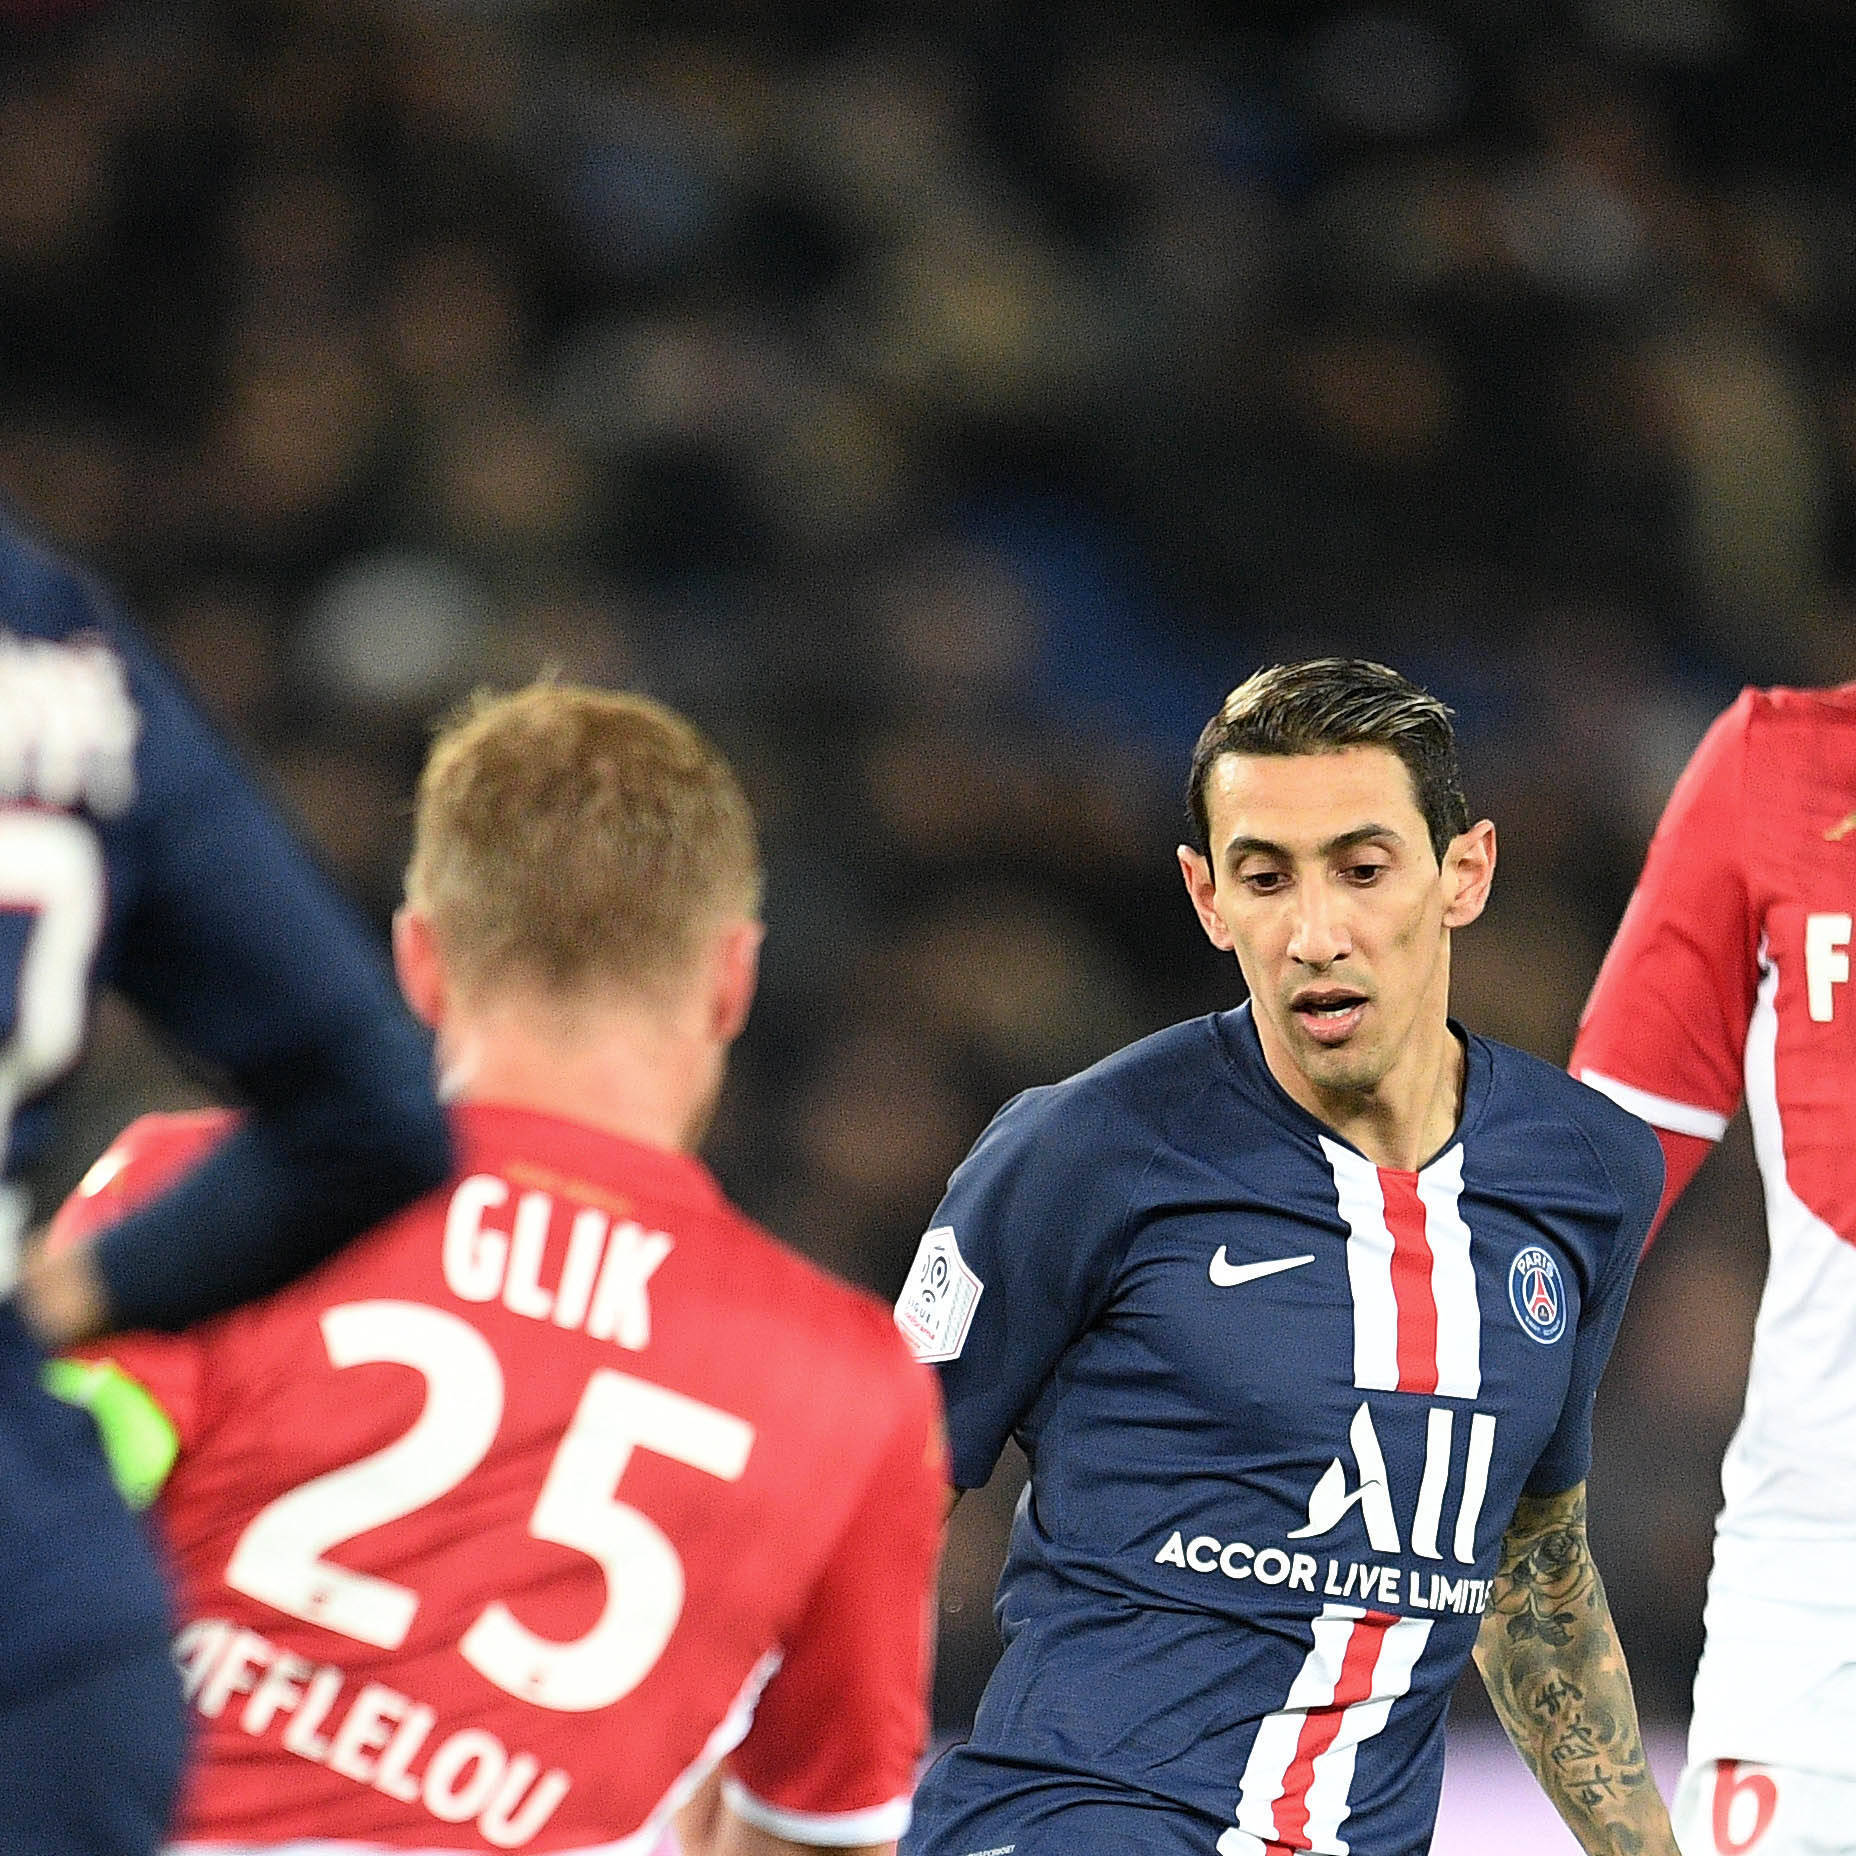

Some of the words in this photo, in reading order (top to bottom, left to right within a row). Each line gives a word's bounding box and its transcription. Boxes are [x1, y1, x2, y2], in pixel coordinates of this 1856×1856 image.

[442, 1174, 673, 1351] GLIK
[1517, 1252, 1554, 1278] PARIS
[225, 1298, 758, 1712] 25
[1154, 1531, 1318, 1593] ACCOR
[1324, 1559, 1401, 1605] LIVE
